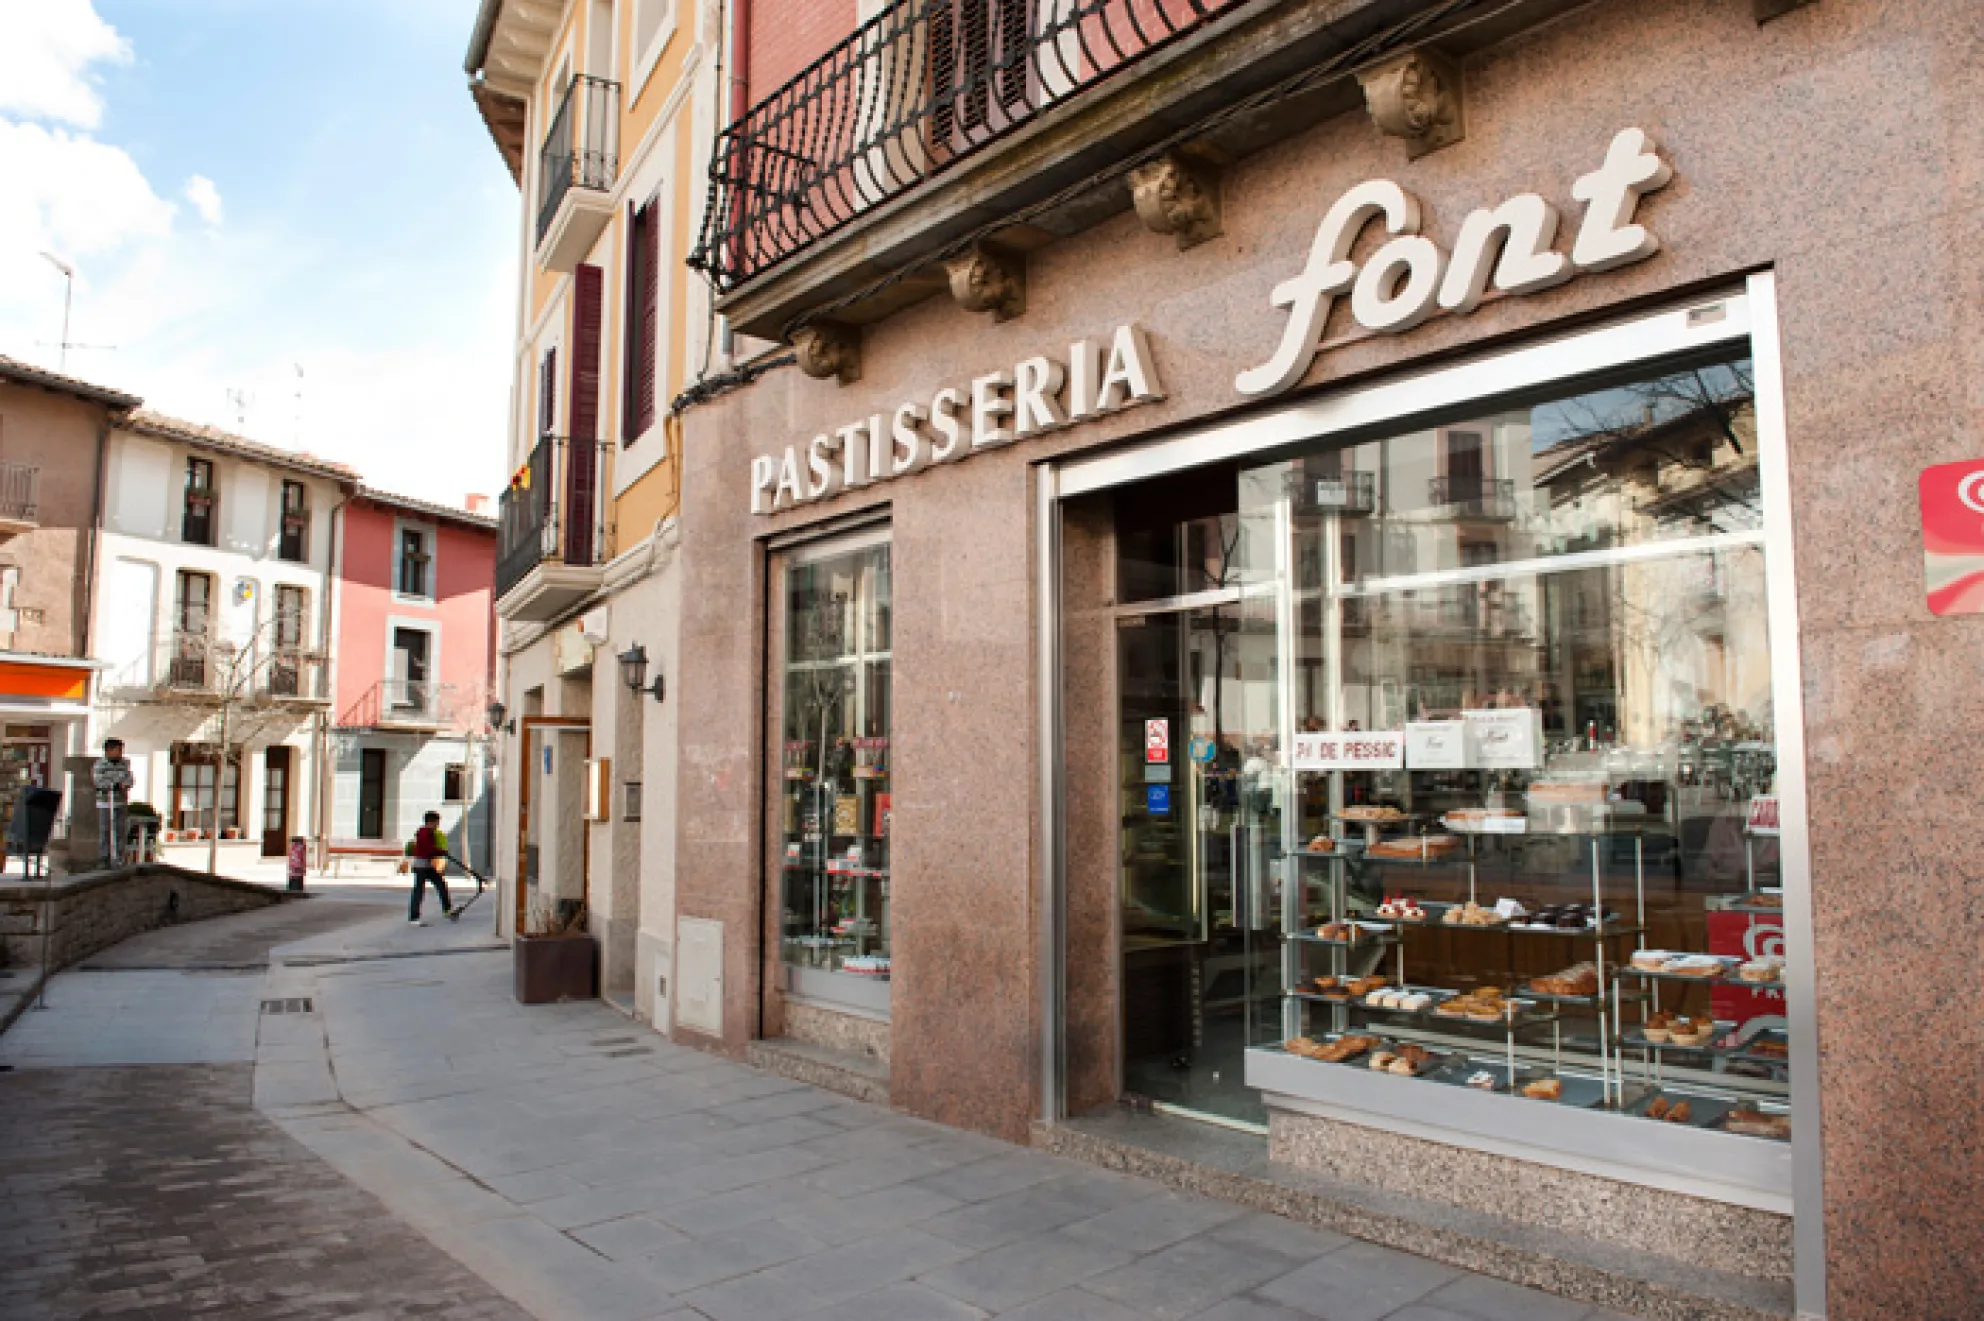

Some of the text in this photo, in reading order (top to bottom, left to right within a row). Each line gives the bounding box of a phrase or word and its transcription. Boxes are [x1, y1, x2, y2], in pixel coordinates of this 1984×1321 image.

[1235, 127, 1671, 397] font
[750, 323, 1164, 515] PASTISSERIA
[1320, 741, 1338, 760] DE
